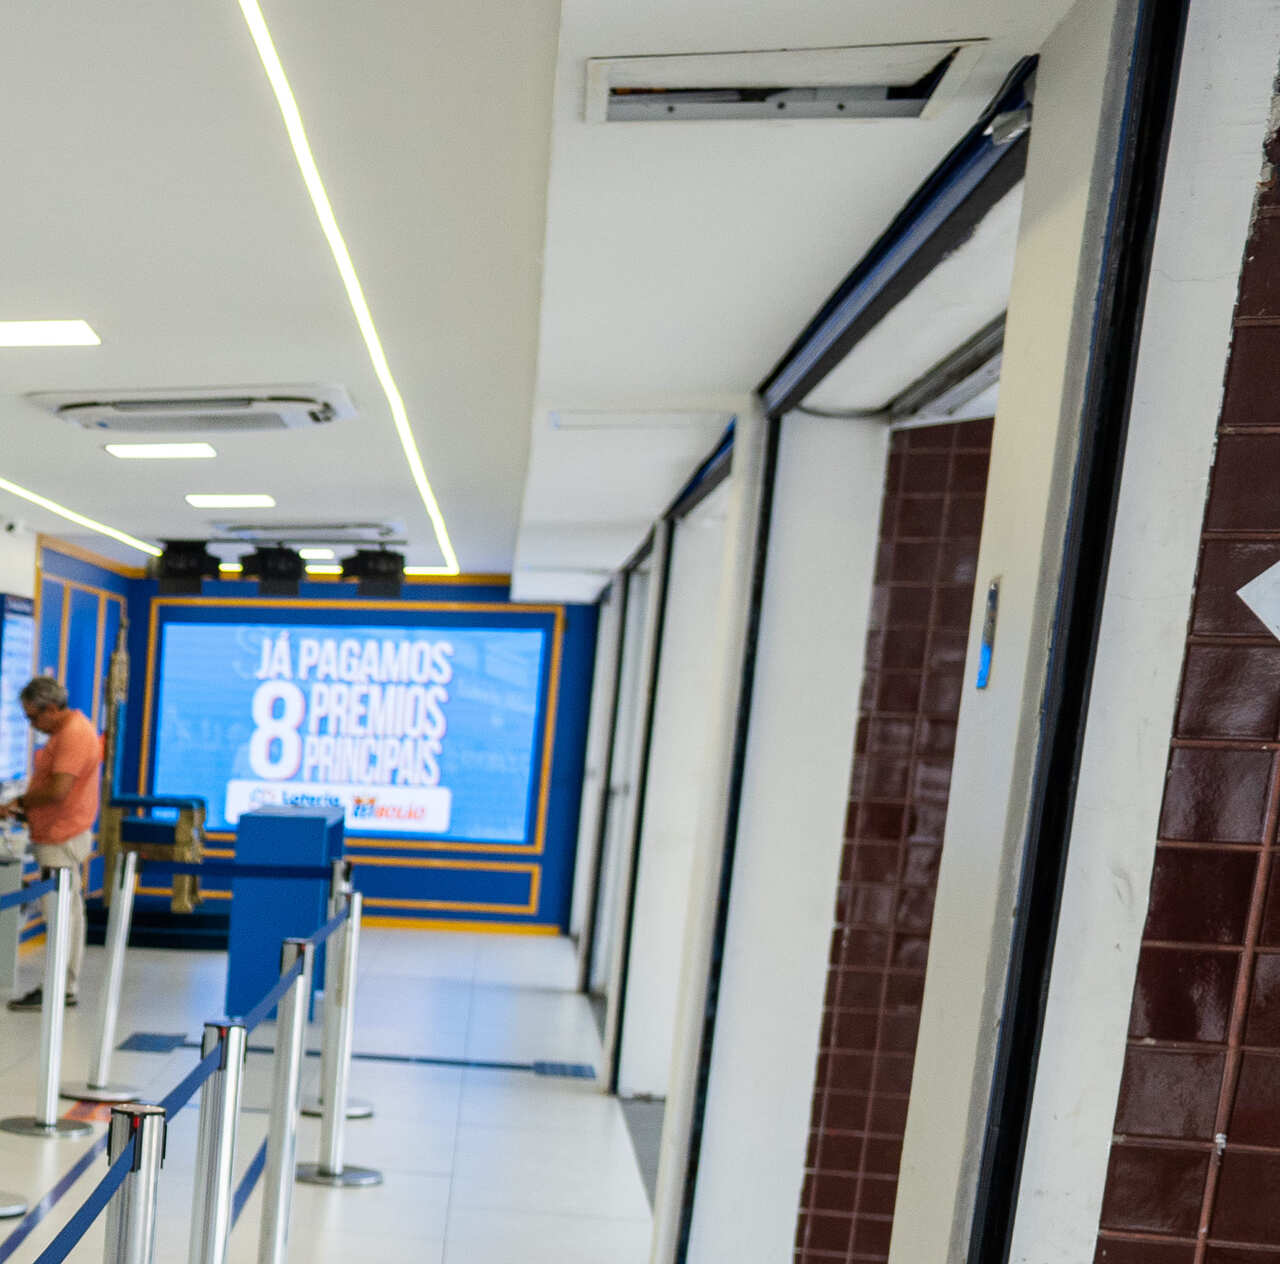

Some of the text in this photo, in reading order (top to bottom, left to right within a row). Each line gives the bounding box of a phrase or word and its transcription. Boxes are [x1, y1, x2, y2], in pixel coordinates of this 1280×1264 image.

[254, 629, 455, 686] JÁ PAGAMOS
[249, 680, 306, 781] 8
[302, 735, 443, 787] PRINCIPAIS
